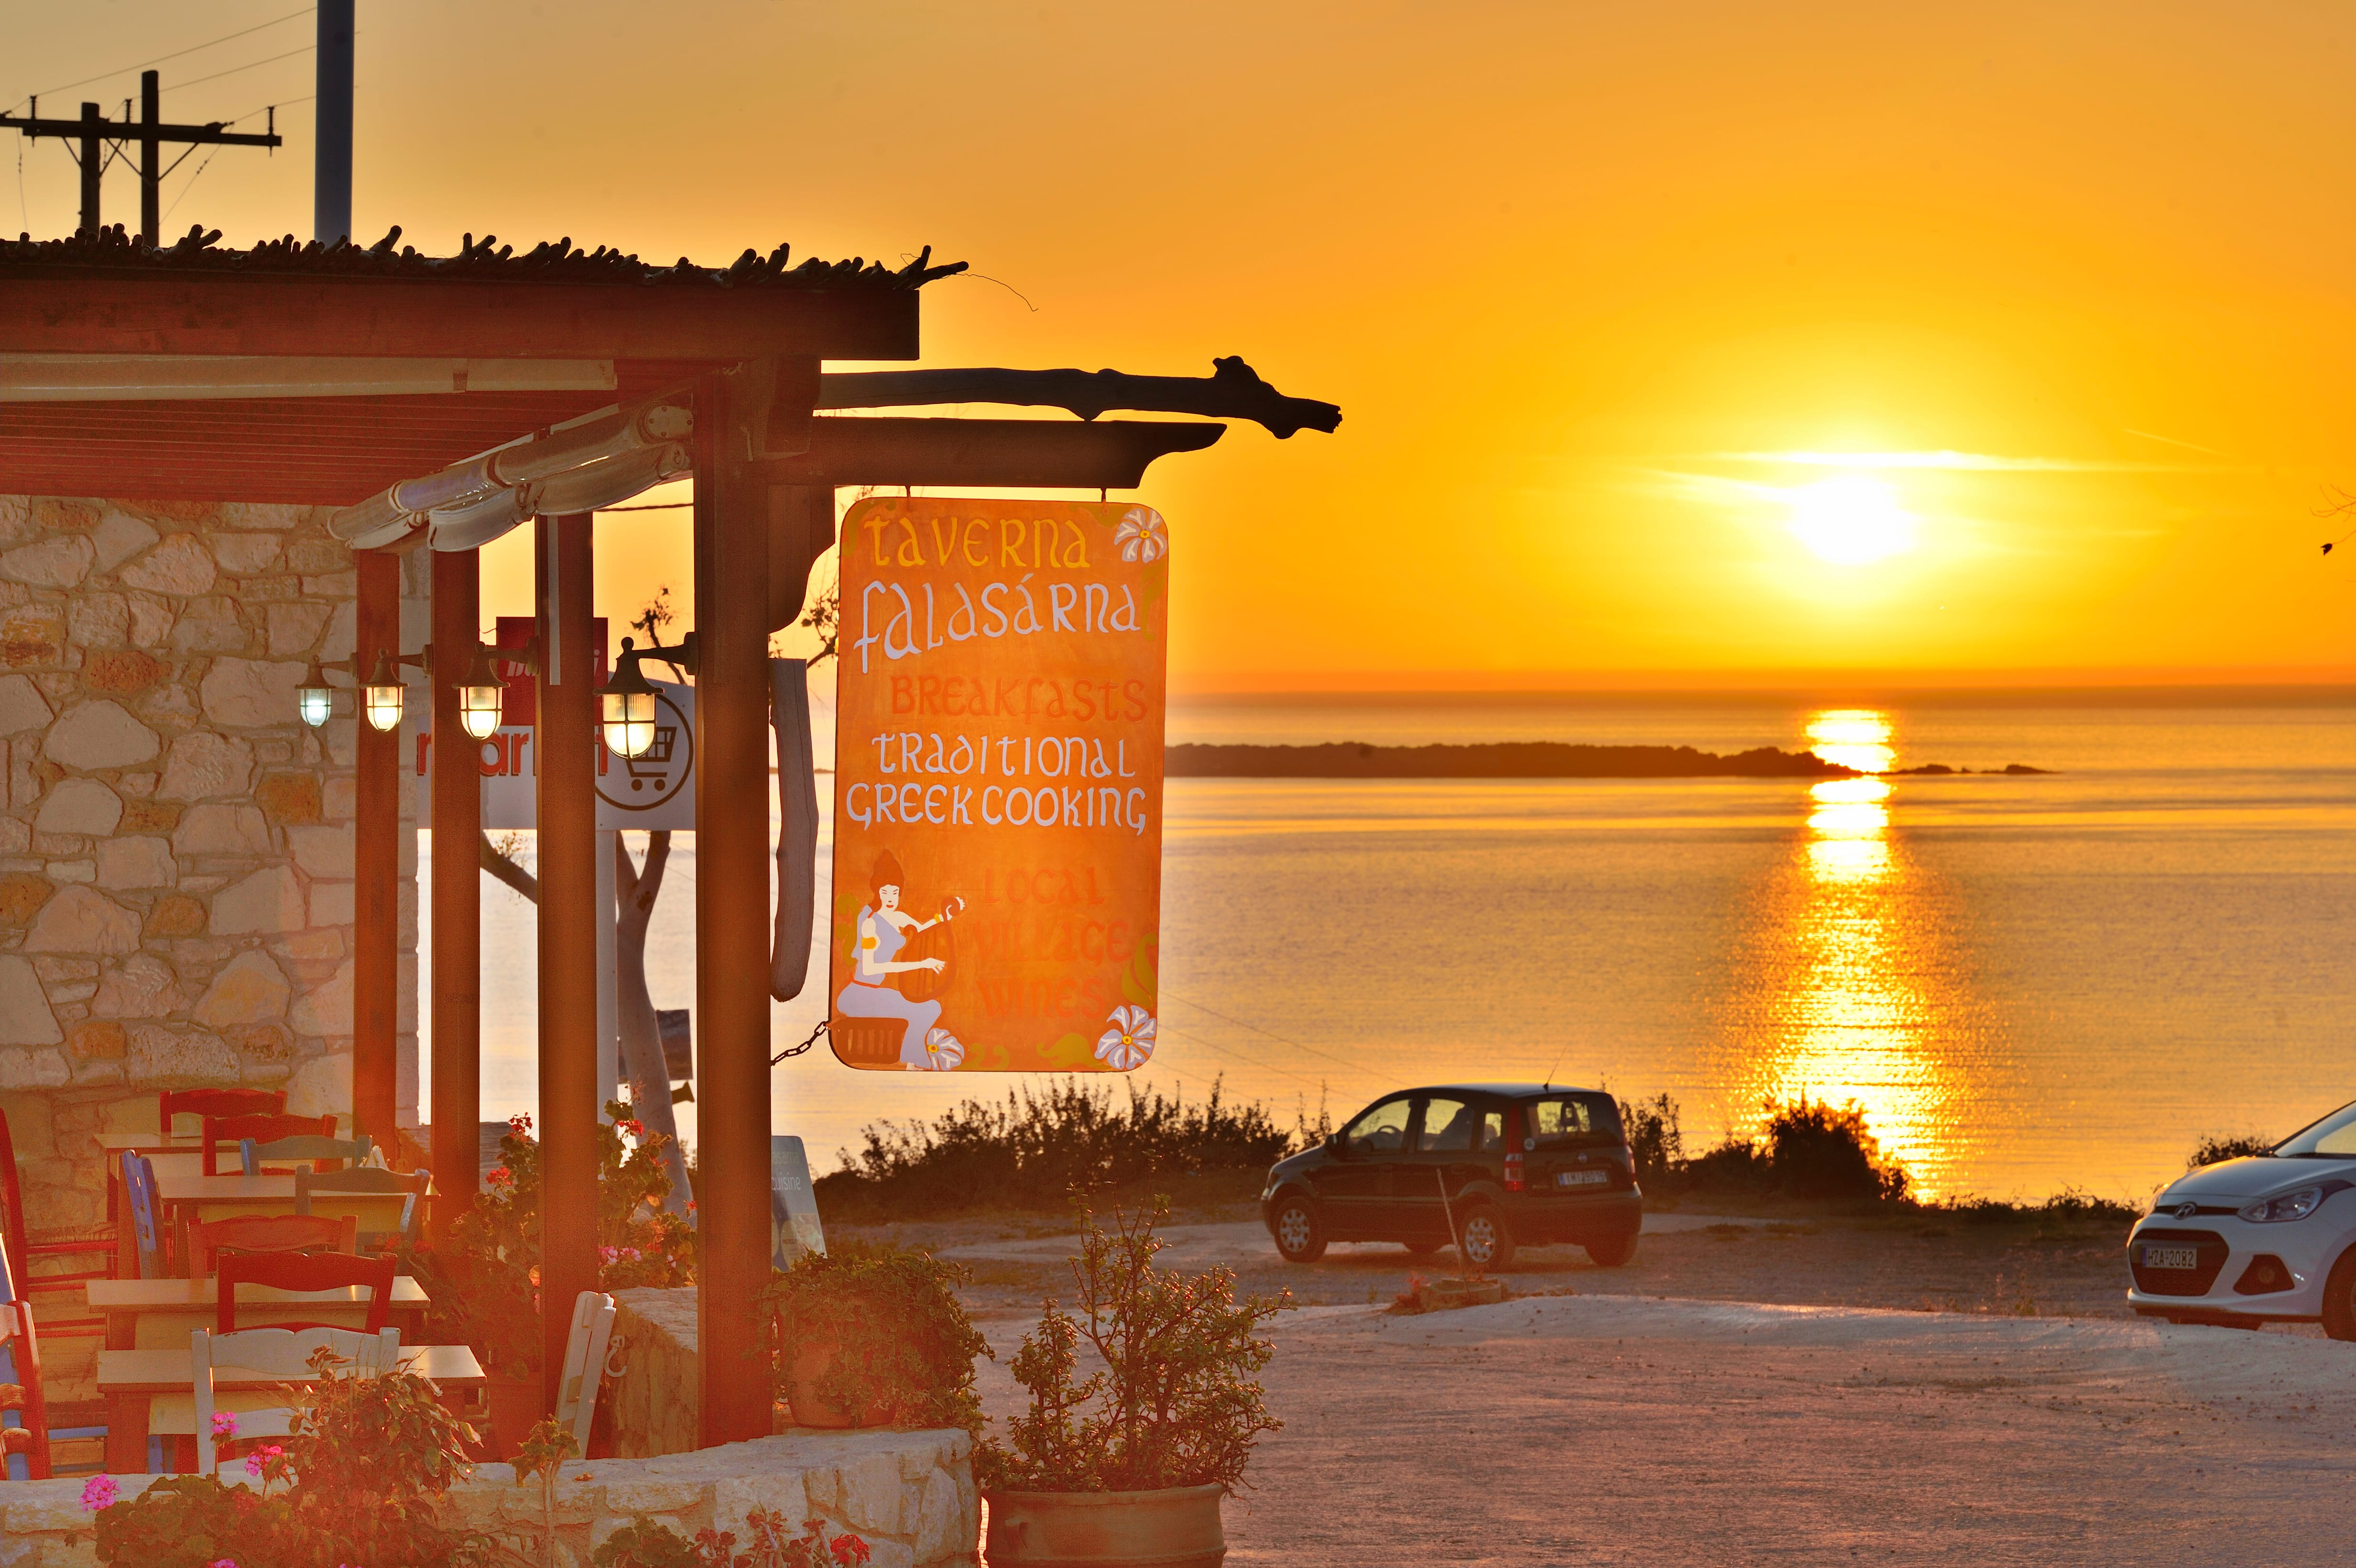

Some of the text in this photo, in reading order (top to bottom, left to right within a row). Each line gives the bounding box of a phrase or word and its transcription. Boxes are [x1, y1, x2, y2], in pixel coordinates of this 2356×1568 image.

[871, 732, 1136, 778] TRADITIONAL
[846, 783, 1146, 836] GREEK COOKING
[983, 866, 1106, 906] LOCAL
[972, 918, 1130, 967] VILLAGE
[976, 976, 1106, 1020] WINES
